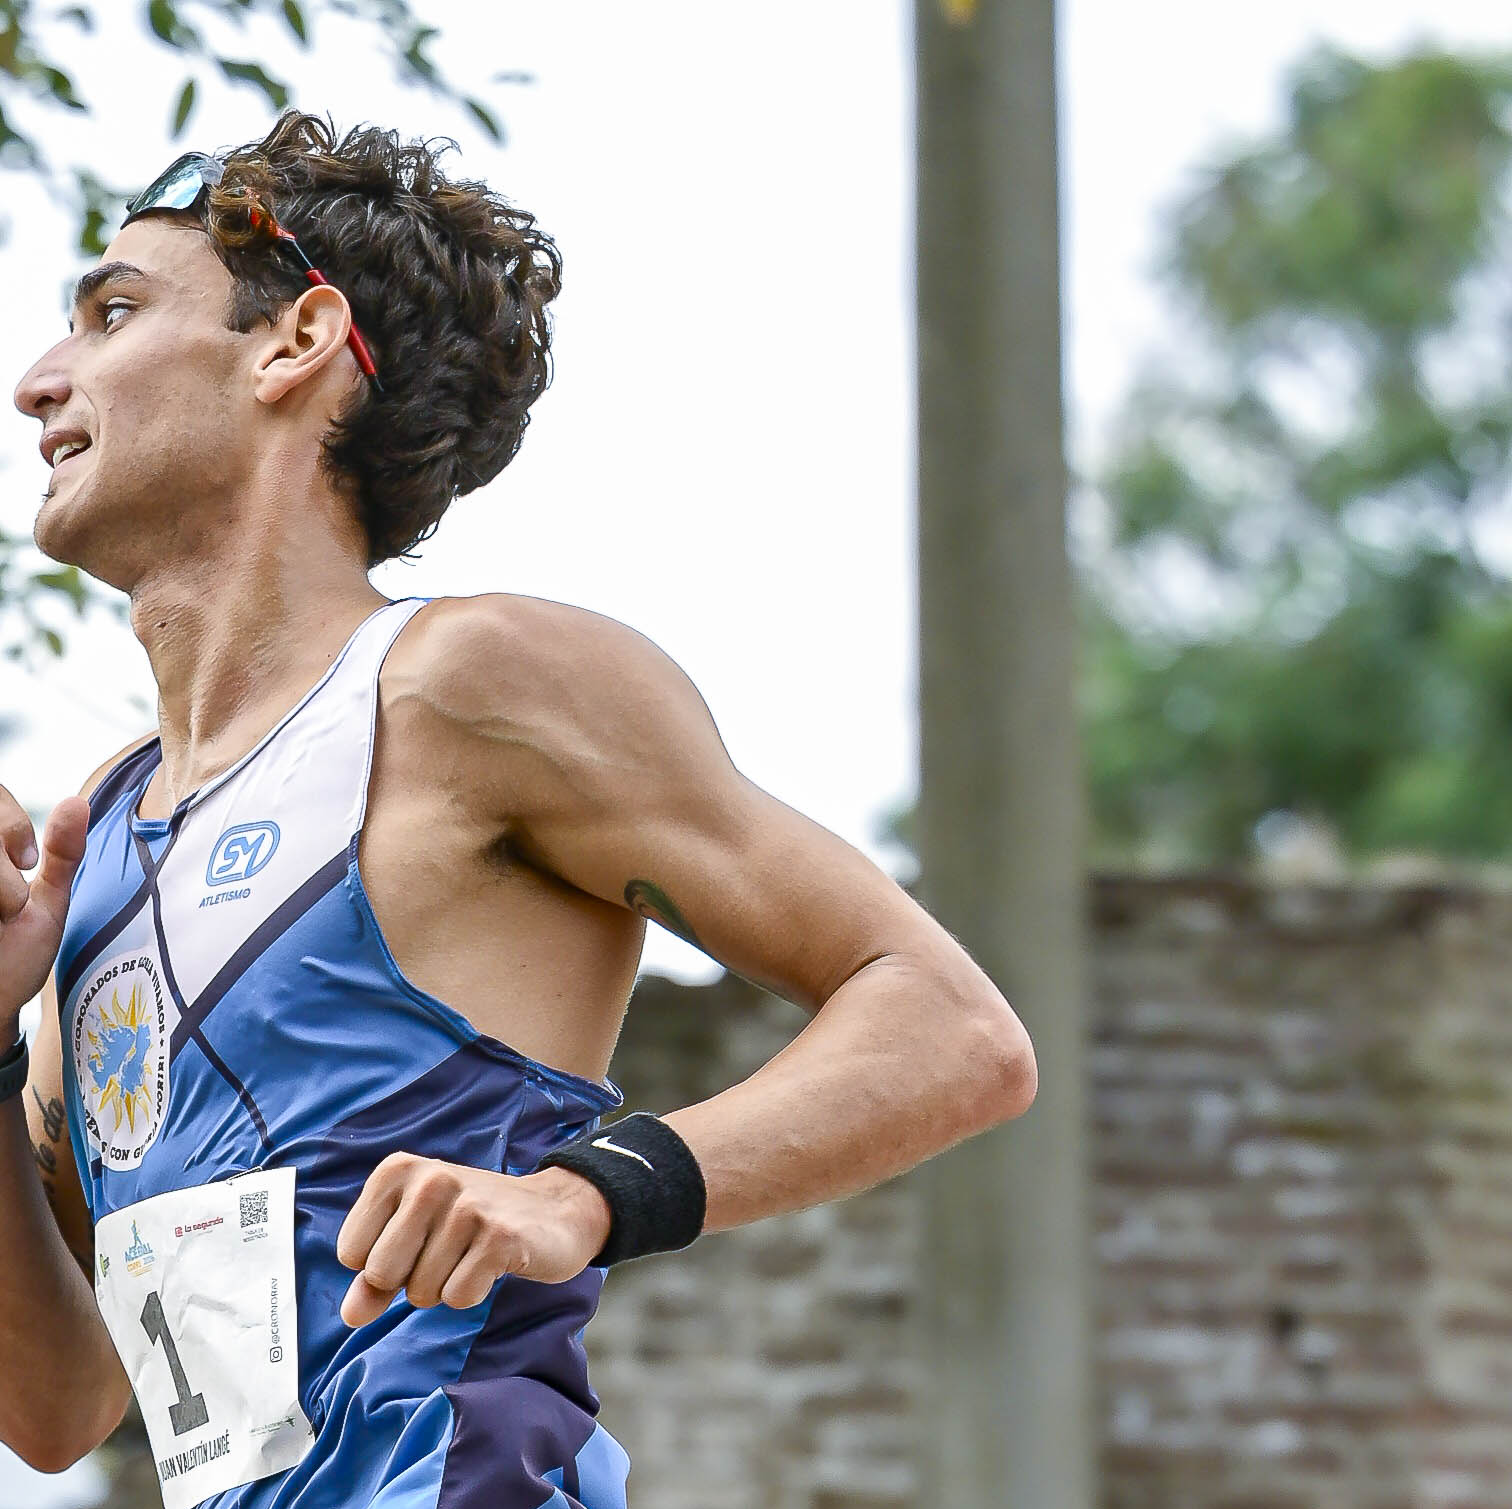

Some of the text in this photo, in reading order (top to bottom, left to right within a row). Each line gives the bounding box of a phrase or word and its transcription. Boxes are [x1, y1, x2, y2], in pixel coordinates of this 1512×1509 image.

[198, 888, 251, 909] ATLETISMO
[75, 965, 118, 1052] CORONADOS
[121, 959, 136, 974] DE
[110, 1146, 130, 1161] CON
[140, 1290, 210, 1437] 1
[158, 1457, 177, 1482] JUAN
